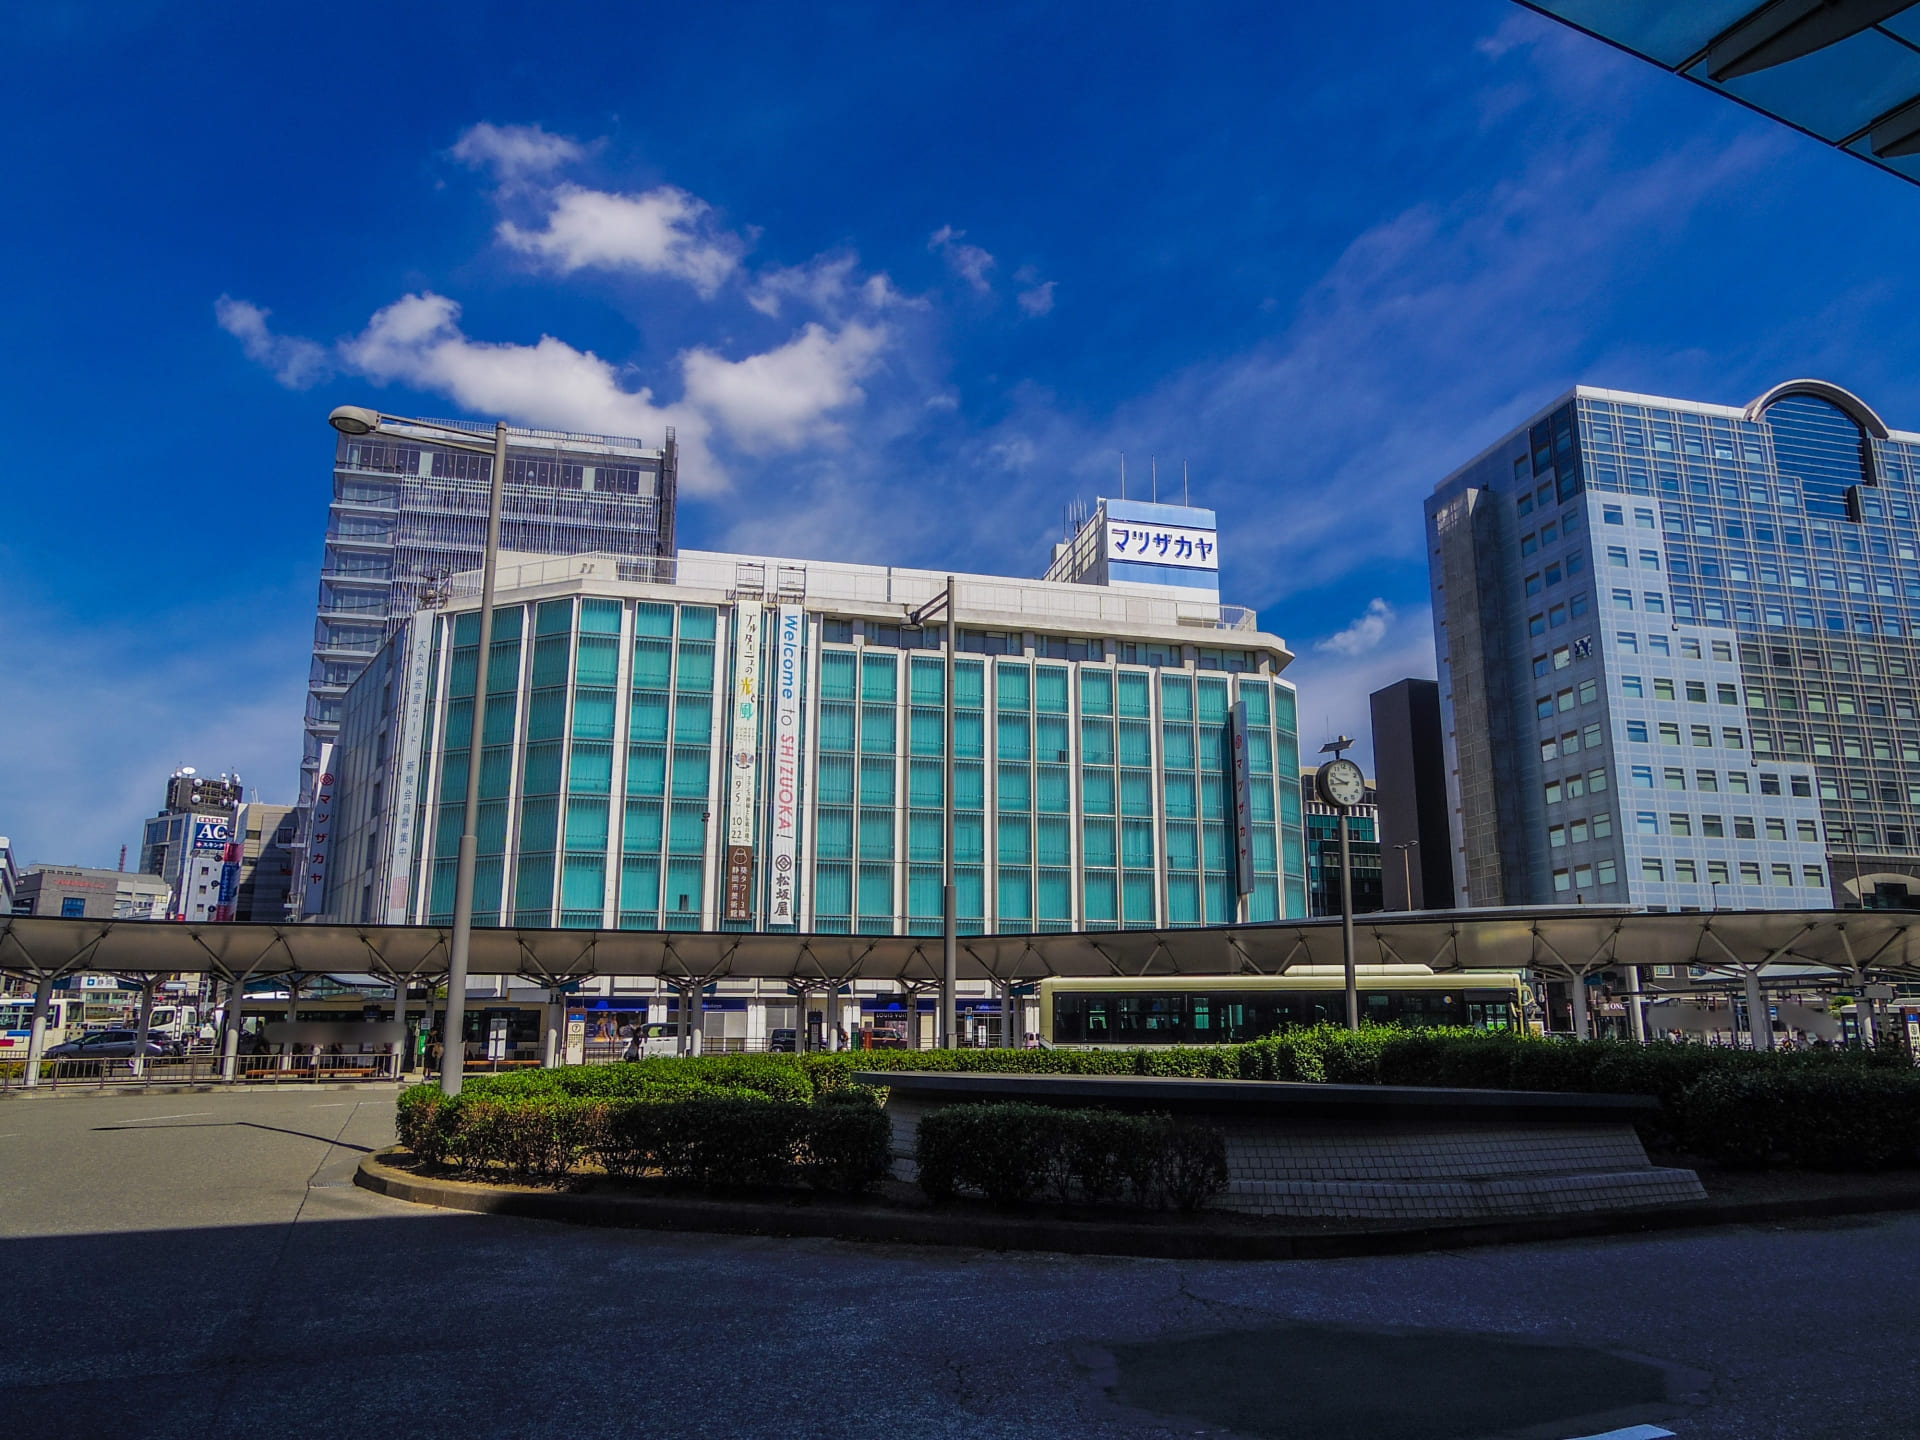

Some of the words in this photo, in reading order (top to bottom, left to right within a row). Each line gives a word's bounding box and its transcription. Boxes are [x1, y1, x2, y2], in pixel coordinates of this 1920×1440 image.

[1111, 528, 1213, 562] マツザカヤ
[783, 615, 798, 700] Welcome
[781, 708, 795, 726] to
[732, 817, 743, 826] 10
[1236, 759, 1248, 860] マツザカヤ
[310, 794, 331, 885] マツザカヤ
[731, 830, 742, 839] 22
[730, 866, 739, 918] 静岡市美術館
[774, 873, 790, 916] 松坂屋
[1855, 988, 1862, 997] 5
